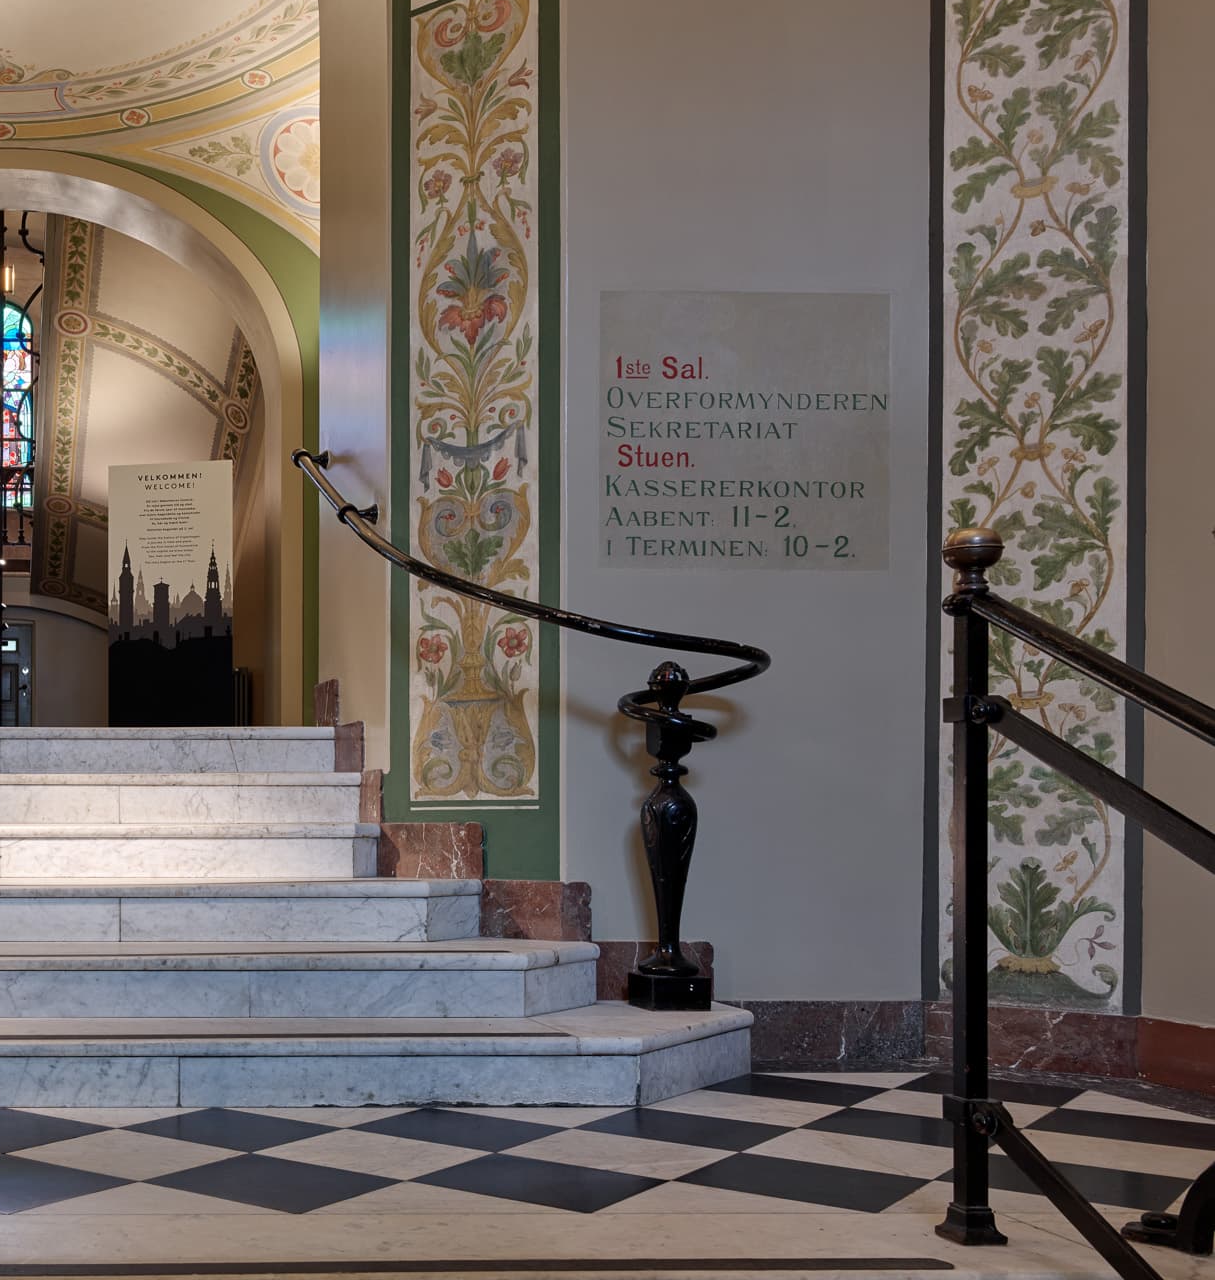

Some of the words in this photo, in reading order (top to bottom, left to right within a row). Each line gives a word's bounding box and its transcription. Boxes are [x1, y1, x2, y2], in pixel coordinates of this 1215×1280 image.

[616, 356, 651, 379] 1ste
[662, 356, 708, 380] Sal.
[607, 386, 887, 411] OVERFORMYNDEREN
[607, 416, 798, 439] SEKRETARIAT
[618, 444, 694, 468] Stuen.
[138, 473, 202, 481] VELKOMMEN!
[144, 482, 195, 490] WELCOME!
[606, 474, 864, 498] KASSERERKONTOR
[626, 536, 768, 557] TERMINEN:
